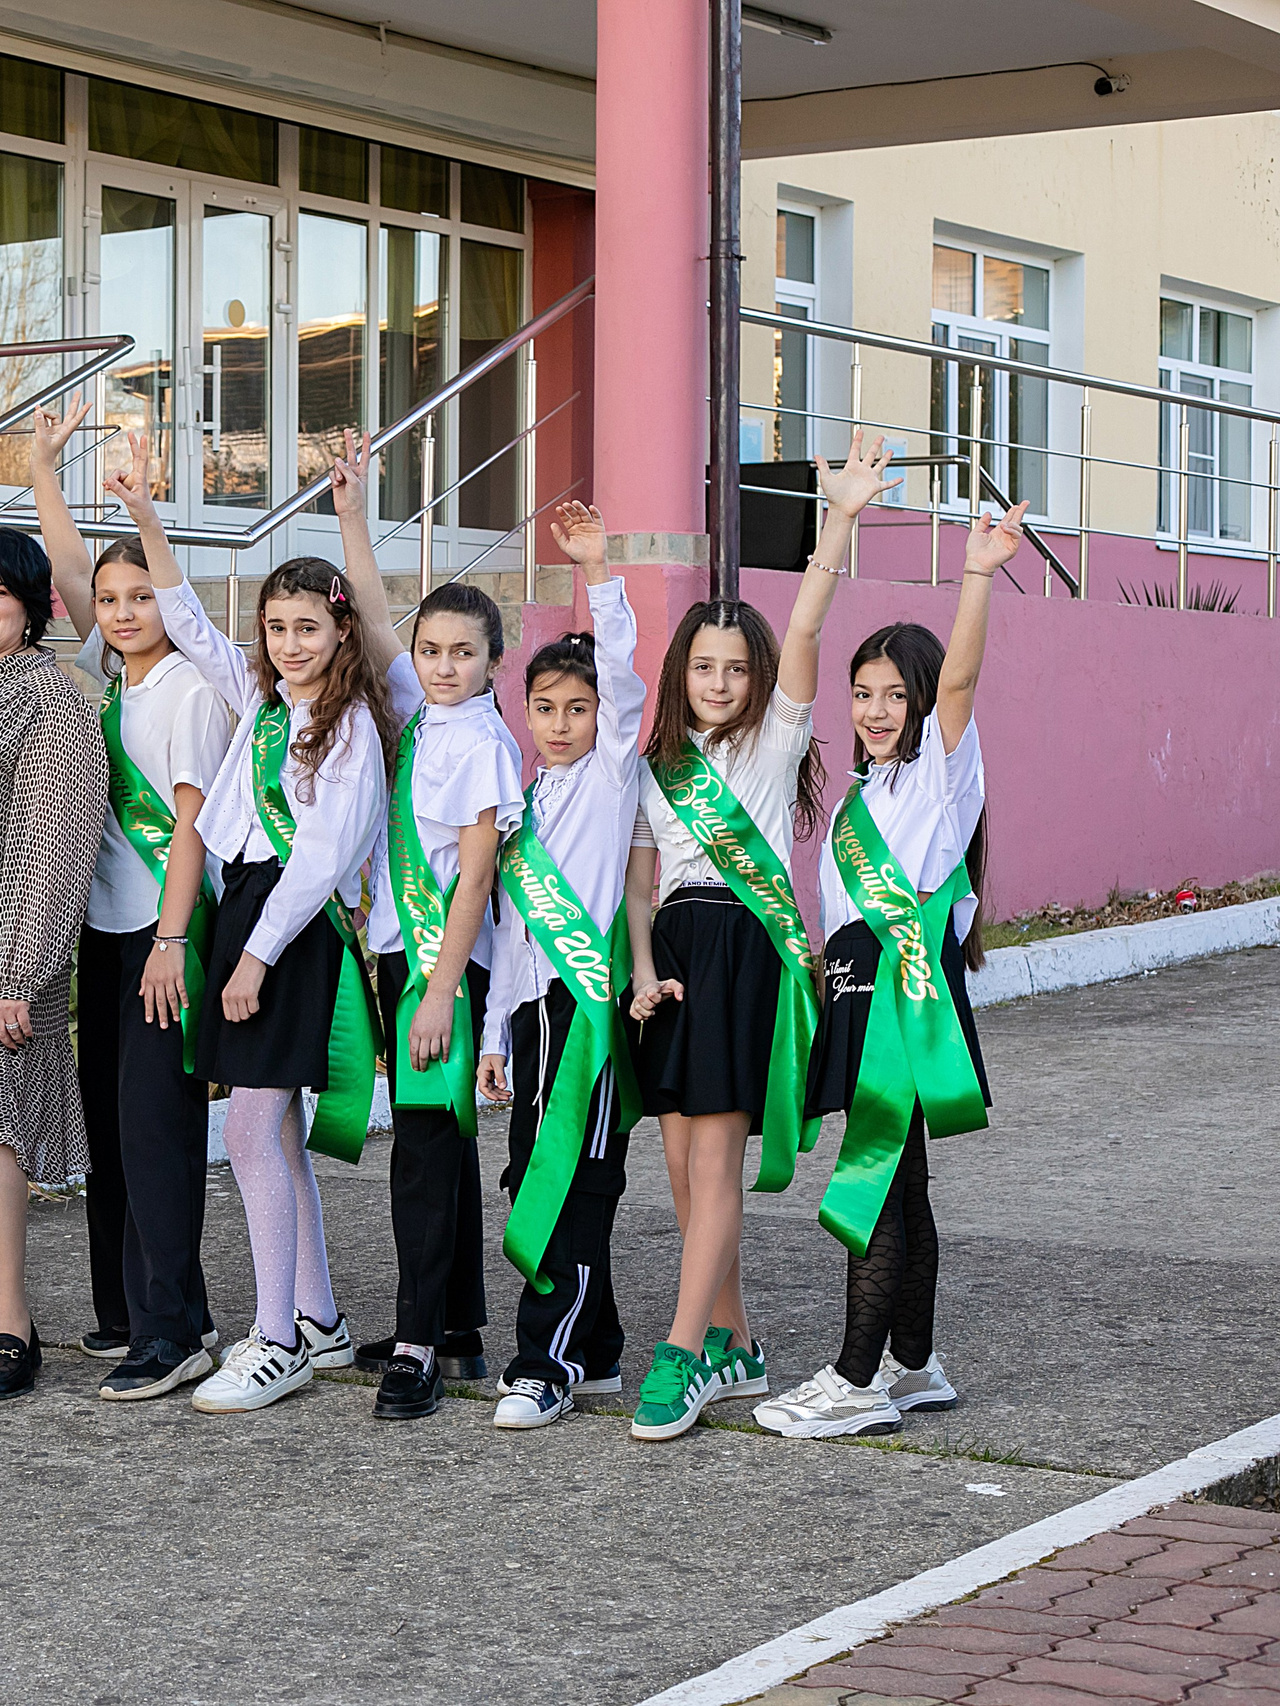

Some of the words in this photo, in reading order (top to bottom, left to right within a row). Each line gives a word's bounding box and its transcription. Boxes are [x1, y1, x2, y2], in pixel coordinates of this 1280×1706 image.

[554, 930, 613, 1002] 2025
[832, 974, 857, 1002] Your
[856, 982, 875, 993] min
[889, 919, 940, 1001] 2025
